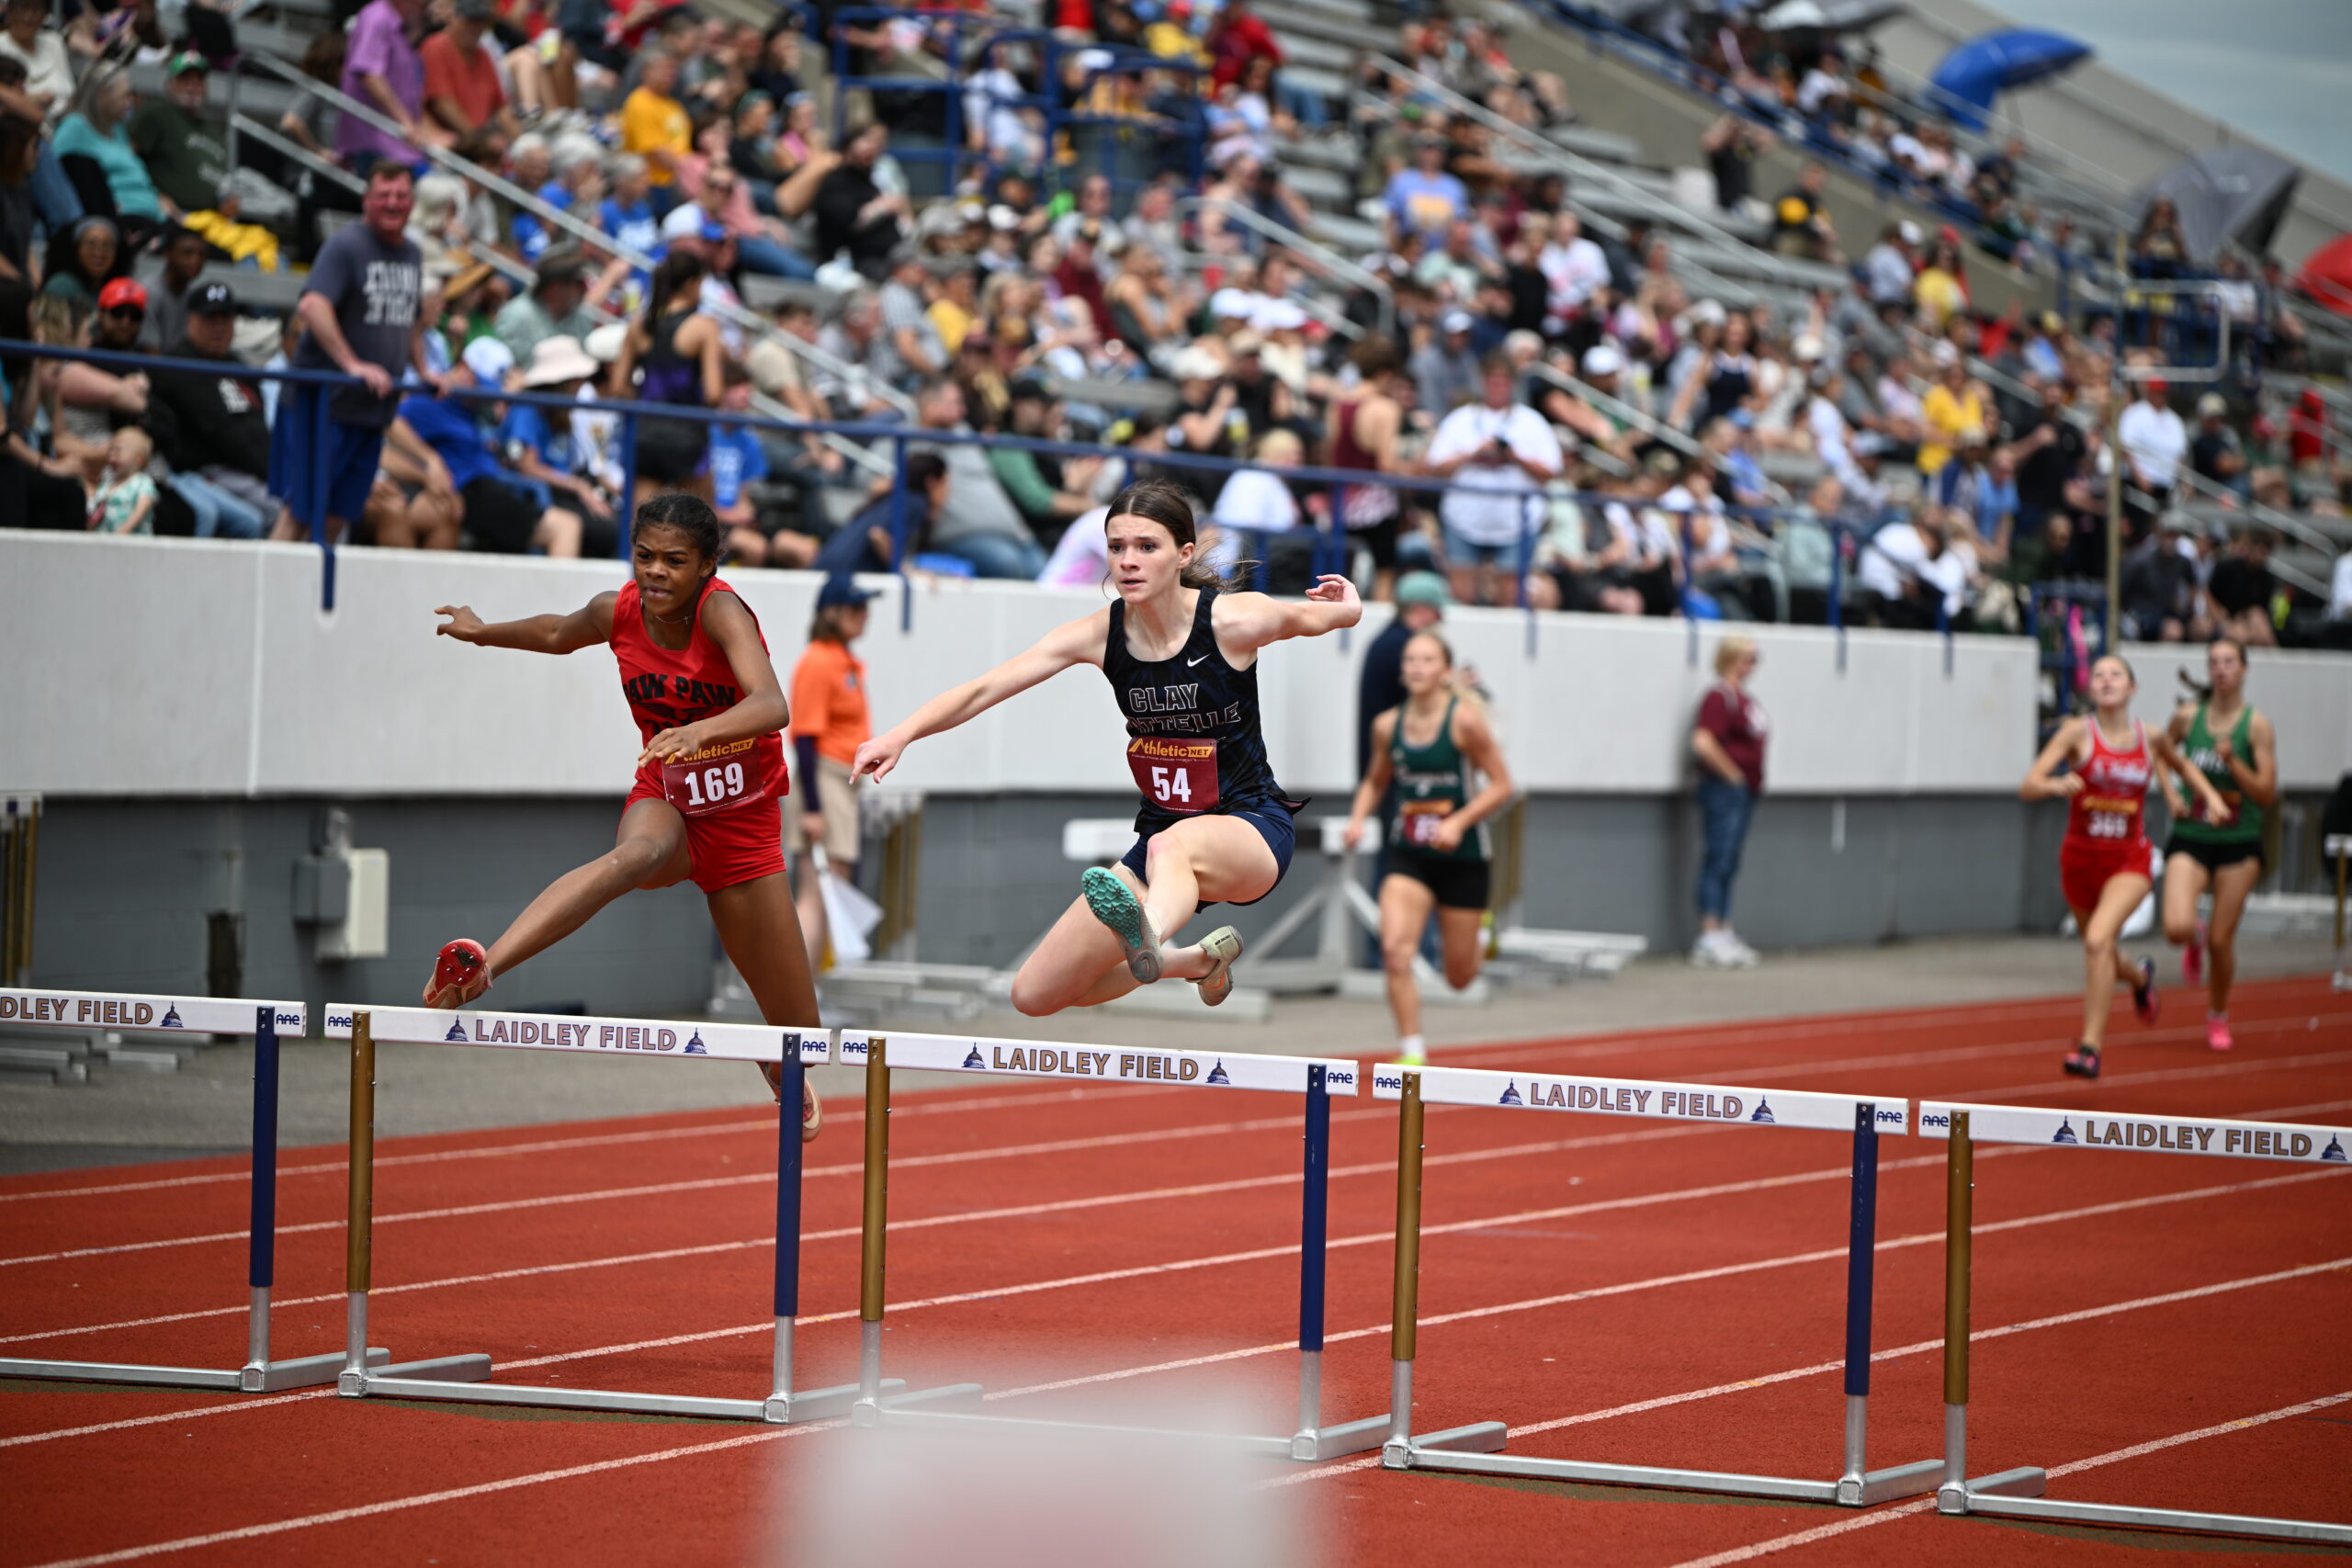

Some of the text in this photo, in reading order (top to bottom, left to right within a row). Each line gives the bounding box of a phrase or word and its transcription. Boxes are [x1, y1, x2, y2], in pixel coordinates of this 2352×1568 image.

[623, 673, 736, 706] AW PAW
[1128, 683, 1198, 713] CLAY
[684, 762, 744, 806] 169
[1151, 766, 1192, 803] 54
[78, 1000, 153, 1025] FIELD
[475, 1019, 677, 1052] LAIDLEY FIELD
[992, 1046, 1199, 1081] LAIDLEY FIELD
[1530, 1082, 1744, 1119] LAIDLEY FIELD
[2086, 1120, 2313, 1156] LAIDLEY FIELD
